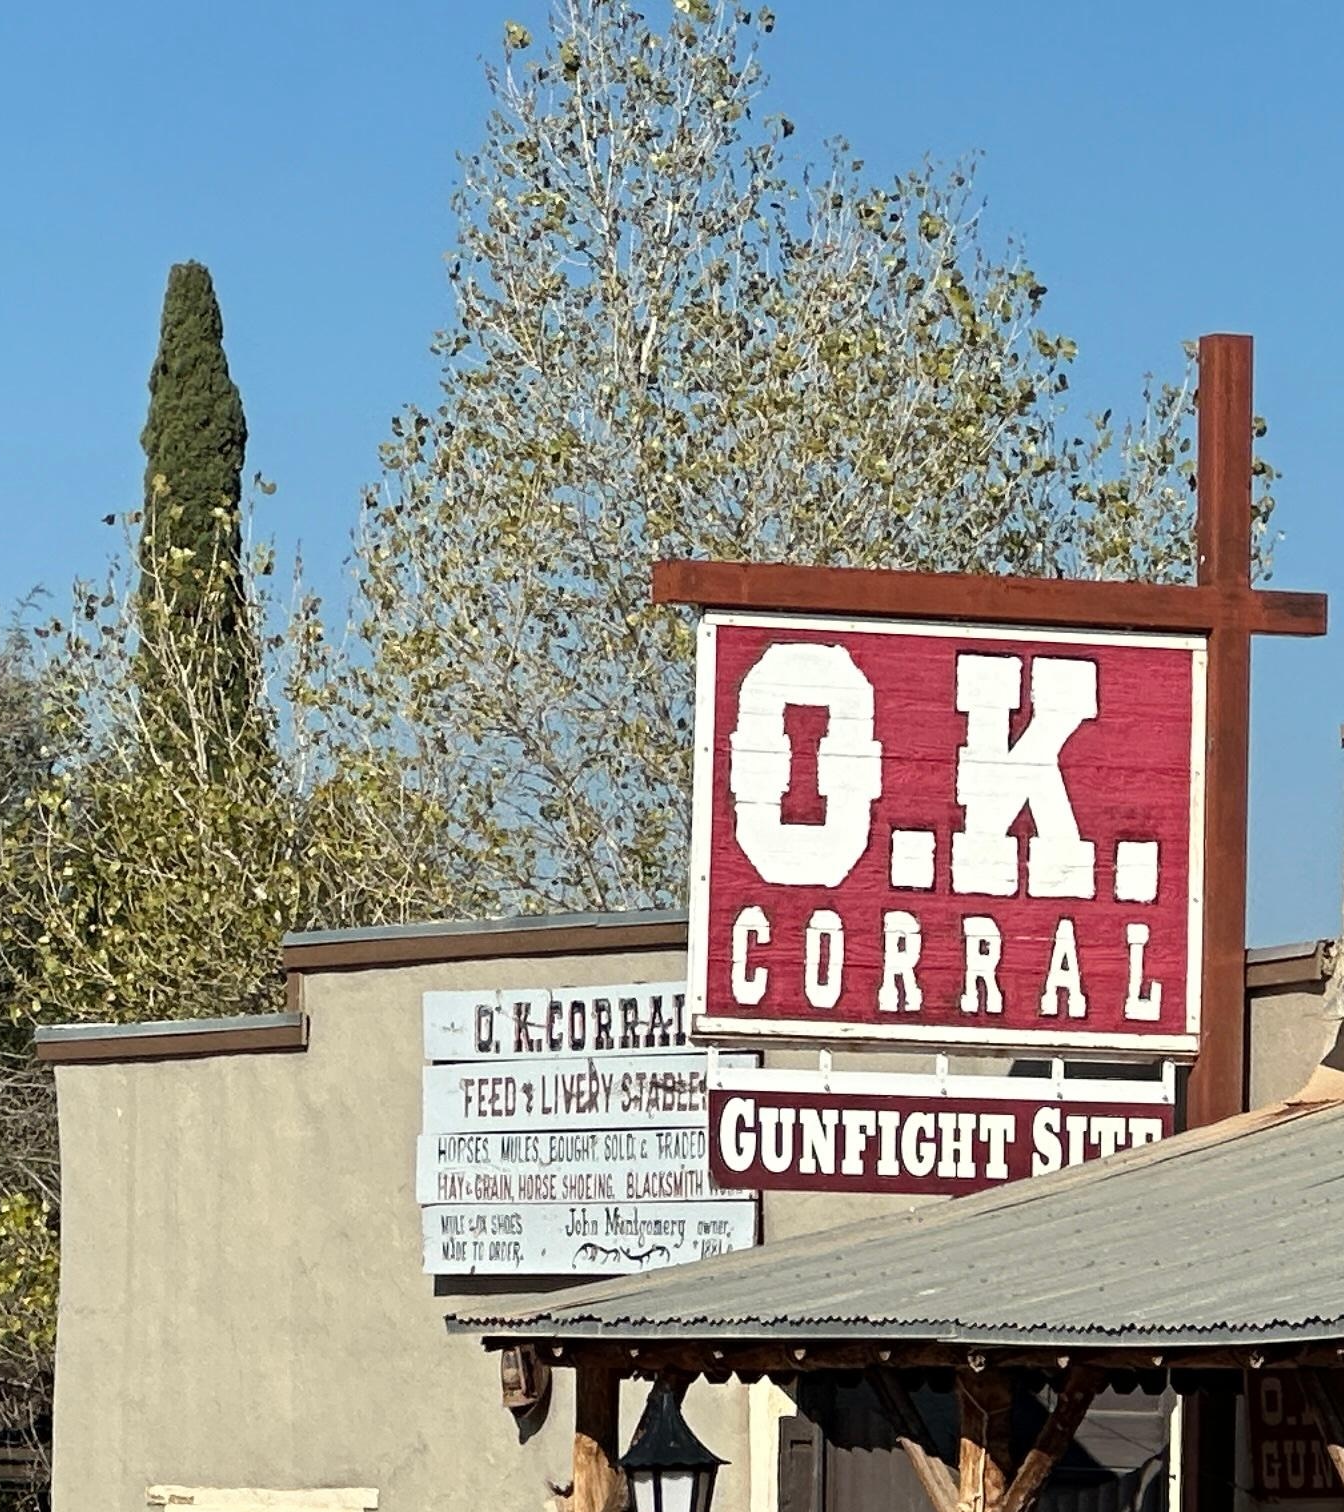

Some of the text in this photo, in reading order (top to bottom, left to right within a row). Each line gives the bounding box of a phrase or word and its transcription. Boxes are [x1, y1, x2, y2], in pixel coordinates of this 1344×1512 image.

[729, 641, 1158, 903] O.K.
[731, 905, 1162, 1021] CORRAL
[460, 1077, 517, 1118] FEED
[542, 1073, 613, 1115] LIVERY
[656, 1131, 706, 1160] TRADED
[719, 1097, 1016, 1180] GUNFIGHT
[519, 1174, 557, 1200] HORSE
[626, 1169, 704, 1199] BLACKSMITH
[491, 1213, 523, 1235] SHOES
[565, 1207, 598, 1237] John
[605, 1207, 686, 1248] Montgomery
